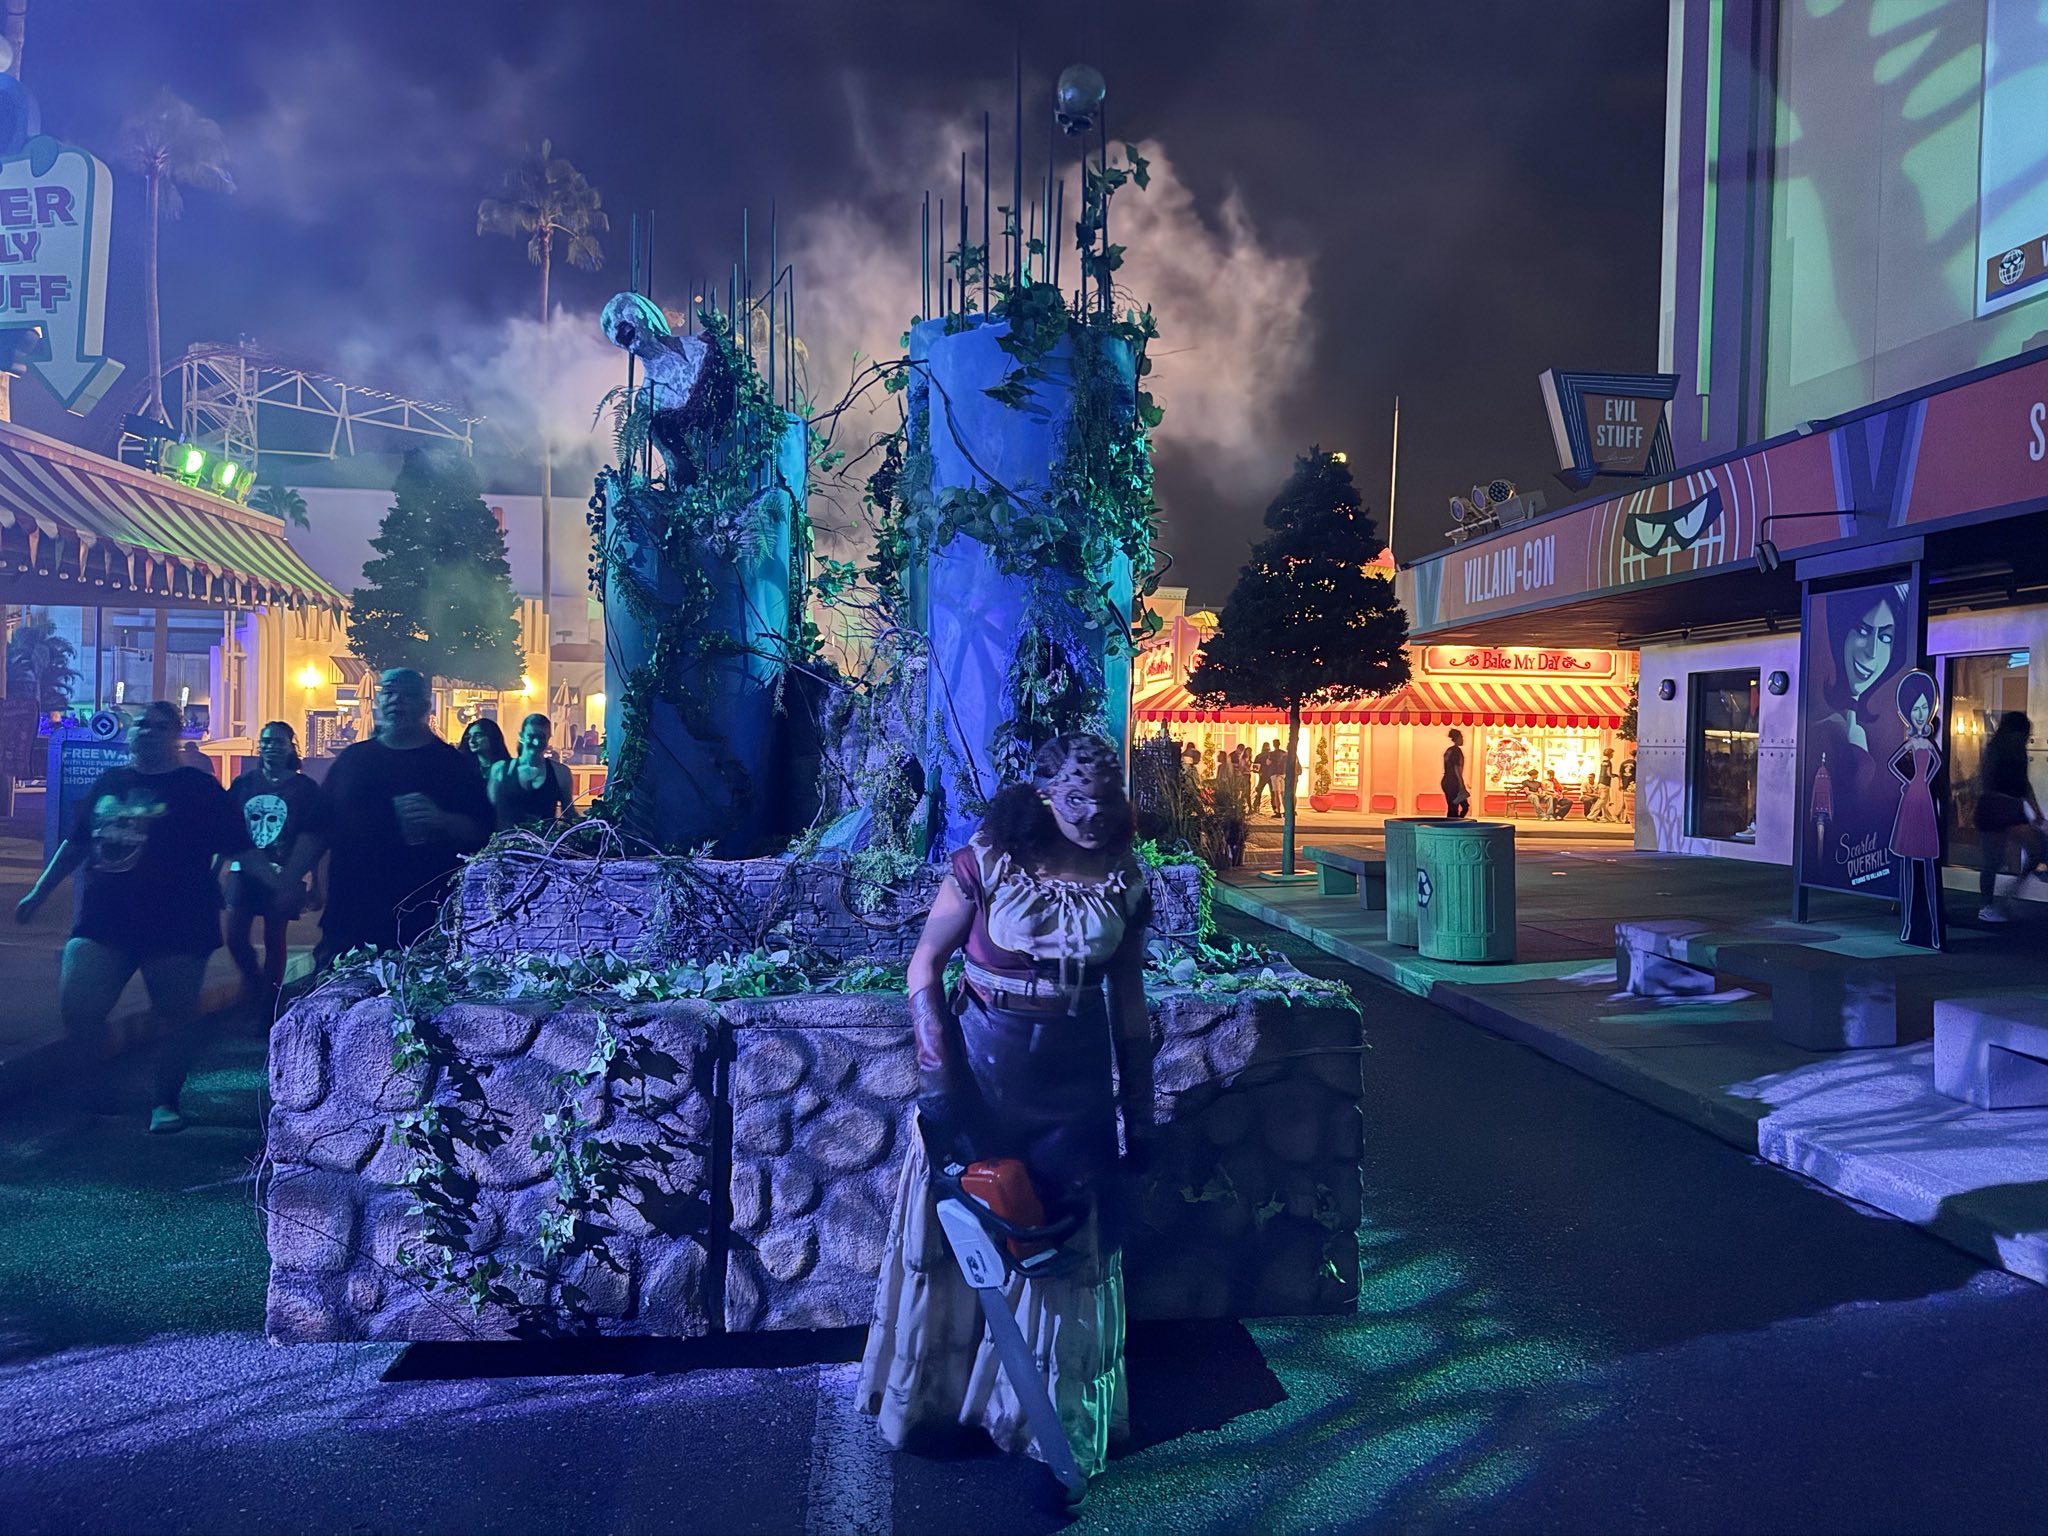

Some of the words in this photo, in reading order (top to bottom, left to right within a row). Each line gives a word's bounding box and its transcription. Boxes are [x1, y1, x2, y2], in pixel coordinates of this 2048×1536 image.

[1605, 399, 1637, 422] EVIL
[1596, 424, 1643, 448] STUFF
[2029, 402, 2046, 461] S
[1464, 534, 1555, 605] VILLAIN-CON
[1482, 651, 1512, 669] Bake
[63, 748, 99, 759] FREE
[1835, 832, 1877, 865] Scarlet
[1847, 847, 1891, 878] OVERKILL
